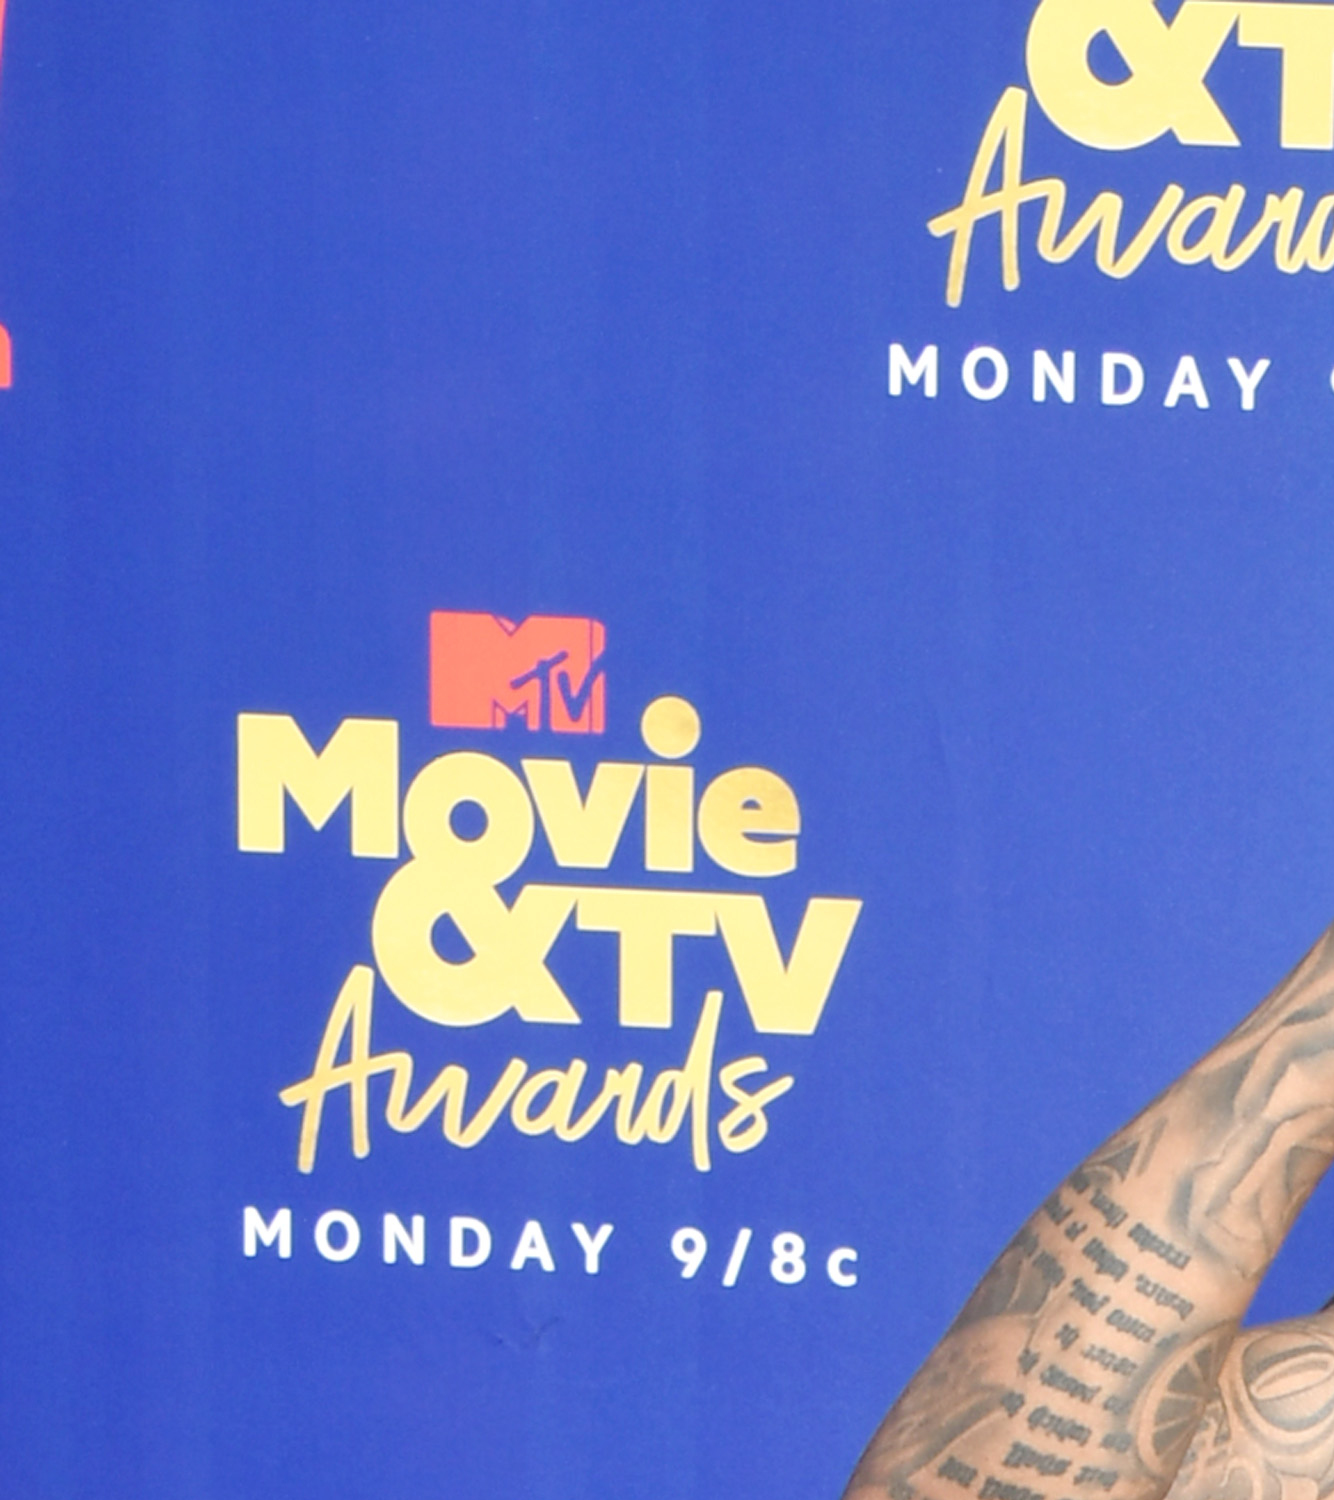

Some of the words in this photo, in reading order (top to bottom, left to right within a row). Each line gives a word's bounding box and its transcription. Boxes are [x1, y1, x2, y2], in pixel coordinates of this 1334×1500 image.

[888, 343, 1270, 411] MONDAY
[430, 609, 606, 734] MTV
[237, 695, 801, 878] Movie
[280, 965, 795, 1173] Awards
[244, 1206, 613, 1275] MONDAY
[671, 1228, 858, 1287] 9/8c
